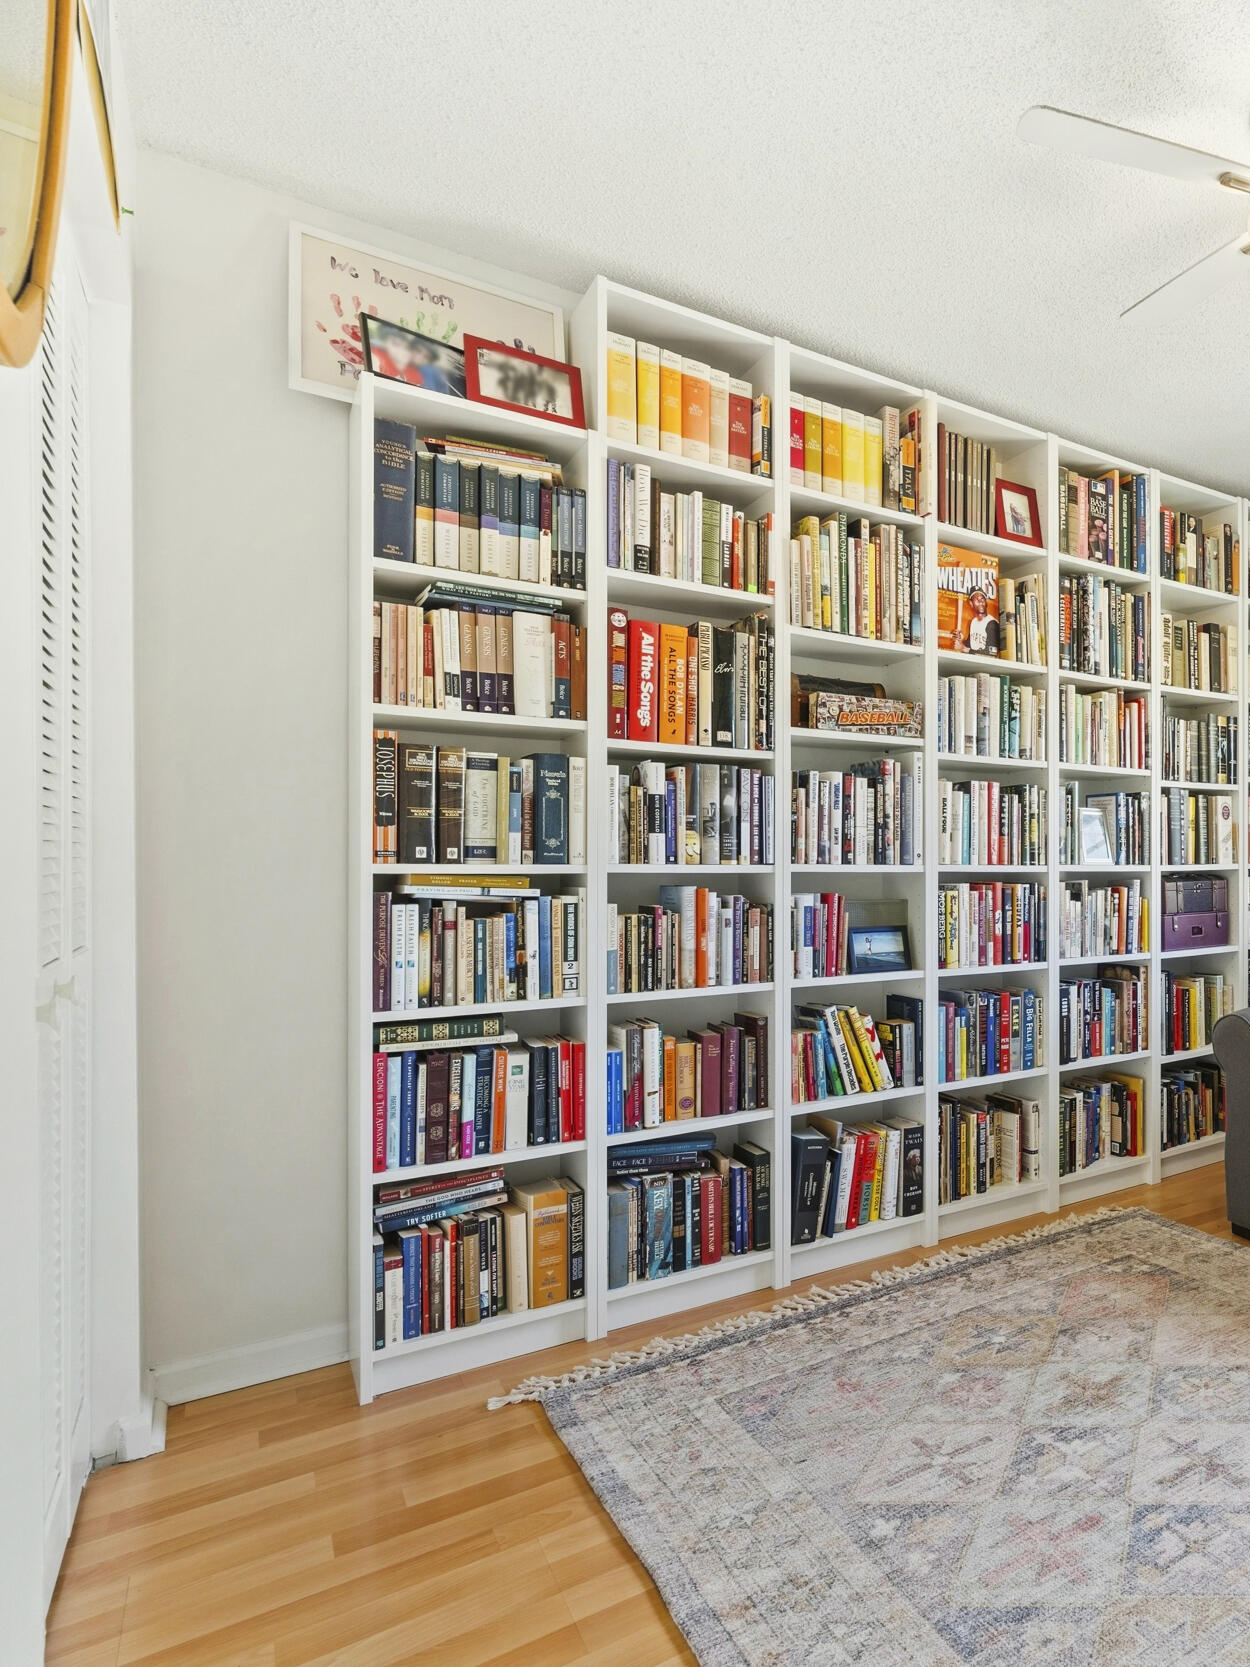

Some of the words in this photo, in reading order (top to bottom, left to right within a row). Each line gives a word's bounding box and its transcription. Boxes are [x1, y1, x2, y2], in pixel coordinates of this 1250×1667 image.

[375, 443, 413, 456] ANALYTICAL
[381, 460, 406, 469] BIBLE
[1091, 498, 1107, 509] BASE
[1091, 504, 1107, 516] BALL
[938, 566, 996, 600] WHEATIES
[464, 624, 472, 654] GENESIS
[483, 626, 491, 656] GENESIS
[642, 632, 654, 654] All
[700, 625, 710, 645] PABLO
[759, 631, 767, 656] THE
[558, 640, 566, 658] ACTS
[668, 647, 676, 664] ALL
[700, 646, 710, 671] PICASSO
[642, 655, 654, 679] the
[668, 668, 676, 686] THE
[759, 660, 768, 692] BEST
[637, 680, 654, 727] Songs
[668, 690, 676, 724] SONGS
[688, 696, 696, 726] HARRIS
[759, 697, 768, 715] OF
[838, 711, 911, 726] BASEBALL
[376, 744, 395, 798] JOSEPHUS
[1026, 1008, 1034, 1020] BIG
[1026, 1022, 1034, 1042] FELLA
[376, 1058, 384, 1093] LENCIONI
[452, 1059, 461, 1094] EXCELLENCE
[496, 1078, 504, 1092] WINS
[476, 1076, 484, 1106] STRATEGIC
[376, 1118, 384, 1159] ADVANTAGE
[612, 1158, 628, 1167] FACE
[632, 1158, 647, 1166] FACE
[654, 1190, 664, 1210] KEY
[406, 1216, 421, 1227] TRY
[422, 1210, 447, 1223] SOFTER
